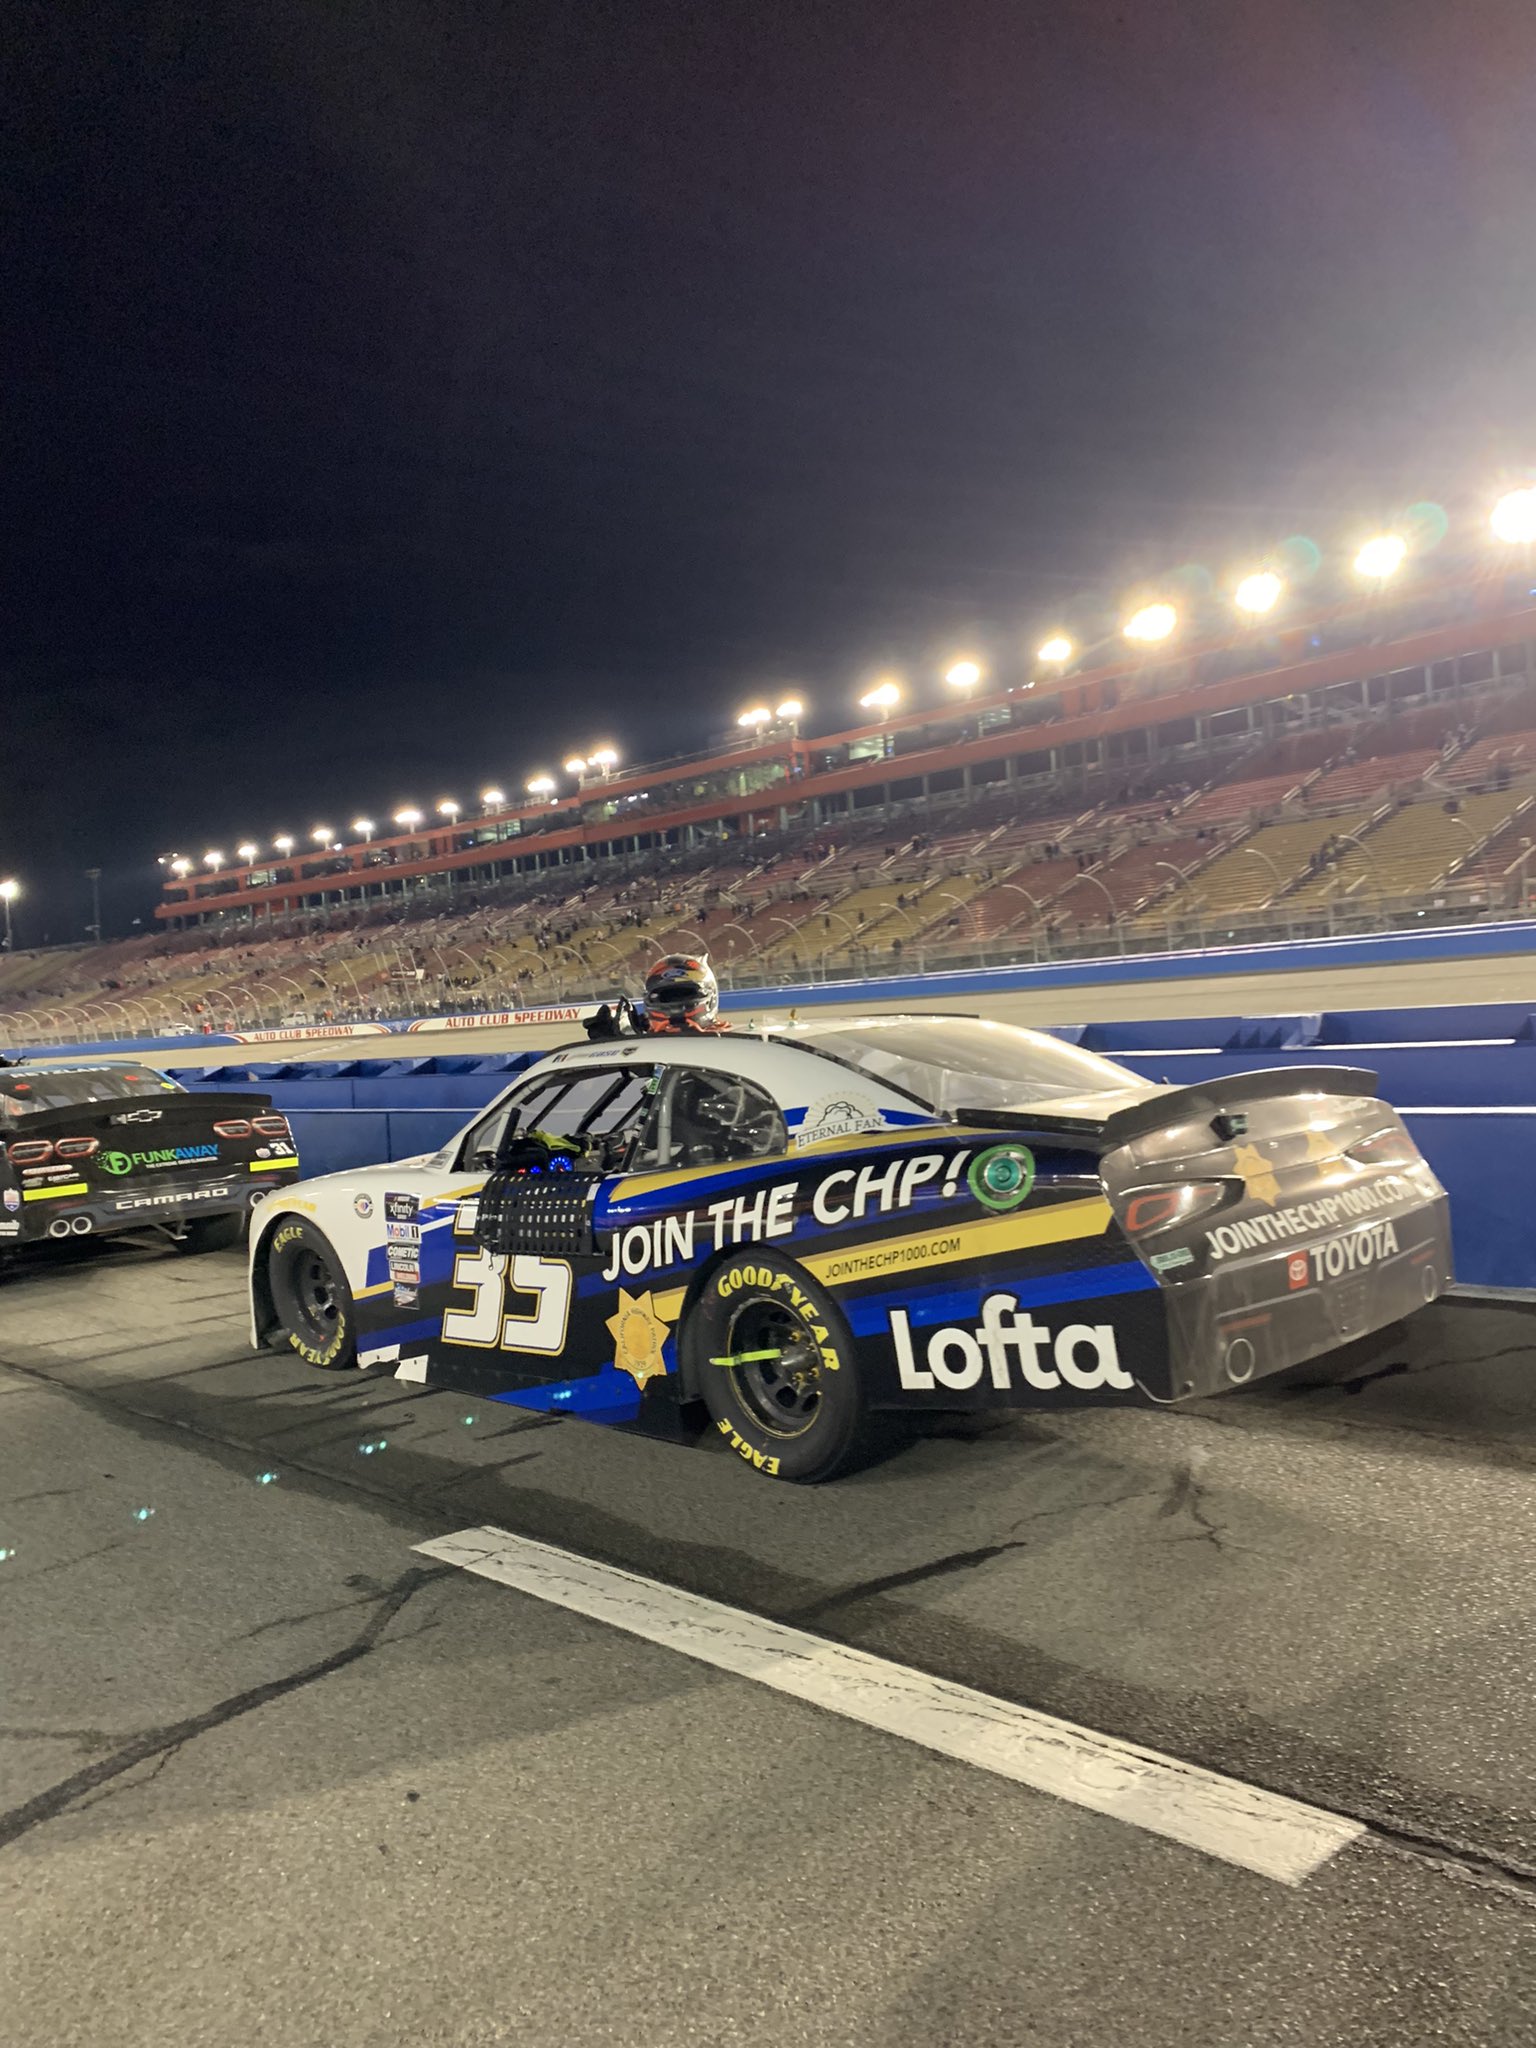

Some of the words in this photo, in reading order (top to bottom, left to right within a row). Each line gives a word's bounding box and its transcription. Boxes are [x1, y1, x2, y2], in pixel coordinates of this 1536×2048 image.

[445, 1016, 475, 1028] AUTO
[480, 1012, 509, 1025] CLUB
[514, 1008, 582, 1023] SPEEDWAY
[253, 1030, 277, 1041] AUTO
[280, 1029, 302, 1040] CLUB
[305, 1025, 354, 1039] SPEEDWAY
[797, 1121, 853, 1147] ETERNAL
[854, 1117, 883, 1133] FAN
[132, 1144, 219, 1164] FUNKAWAY
[269, 1142, 294, 1155] 31
[116, 1187, 228, 1210] CAMARO
[389, 1201, 413, 1217] xfinity
[602, 1211, 694, 1281] JOIN
[708, 1182, 799, 1251] THE
[813, 1150, 972, 1225] CHP!
[273, 1226, 303, 1253] EAGLE
[387, 1223, 410, 1239] Mobil
[411, 1225, 419, 1239] 1
[388, 1245, 419, 1259] COMETIC
[826, 1237, 961, 1279] JOINTHECHP1000.COM
[1309, 1223, 1398, 1281] TOYOTA
[718, 1265, 840, 1372] GOODYEAR
[888, 1293, 1135, 1390] Lofta
[717, 1418, 780, 1476] EAGLE
